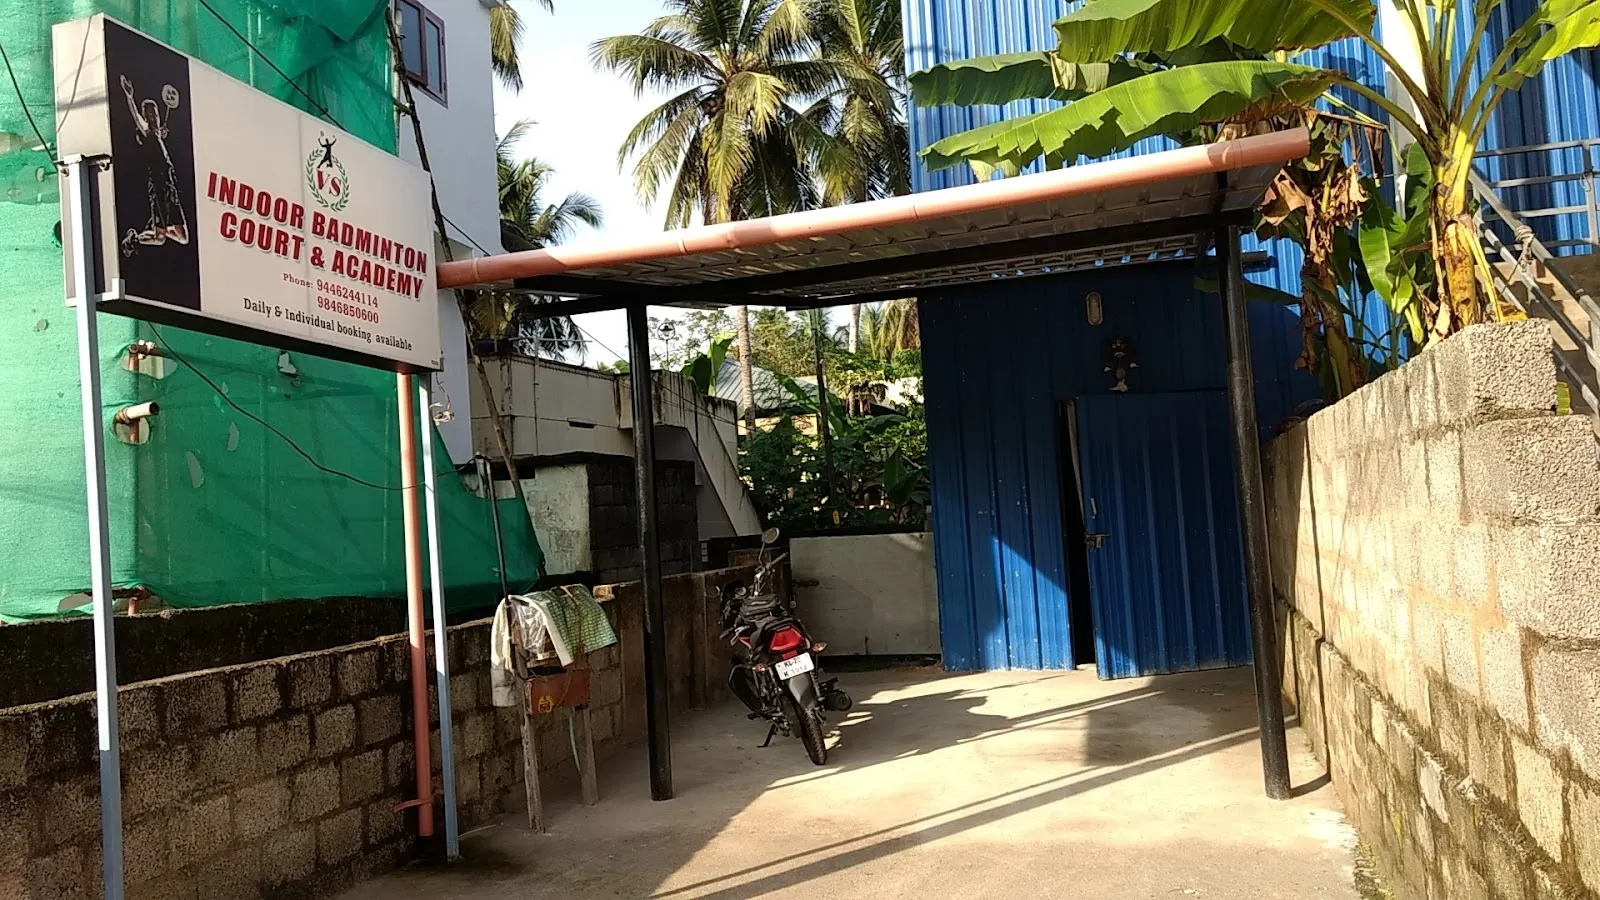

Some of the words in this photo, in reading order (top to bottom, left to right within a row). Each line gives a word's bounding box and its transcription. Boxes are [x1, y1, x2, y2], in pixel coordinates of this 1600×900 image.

[315, 169, 343, 198] VS
[206, 171, 305, 230] INDOOR
[311, 210, 428, 275] BADMINTON
[219, 211, 305, 261] COURT
[310, 246, 325, 269] &
[331, 249, 424, 299] ACADEMY
[282, 272, 314, 289] Phone:
[316, 278, 379, 308] 9446244114
[317, 295, 380, 324] 9846850600
[243, 297, 272, 318] Daily
[274, 305, 283, 317] &
[284, 308, 335, 332] Individual
[337, 320, 372, 344] booking
[375, 333, 413, 352] available
